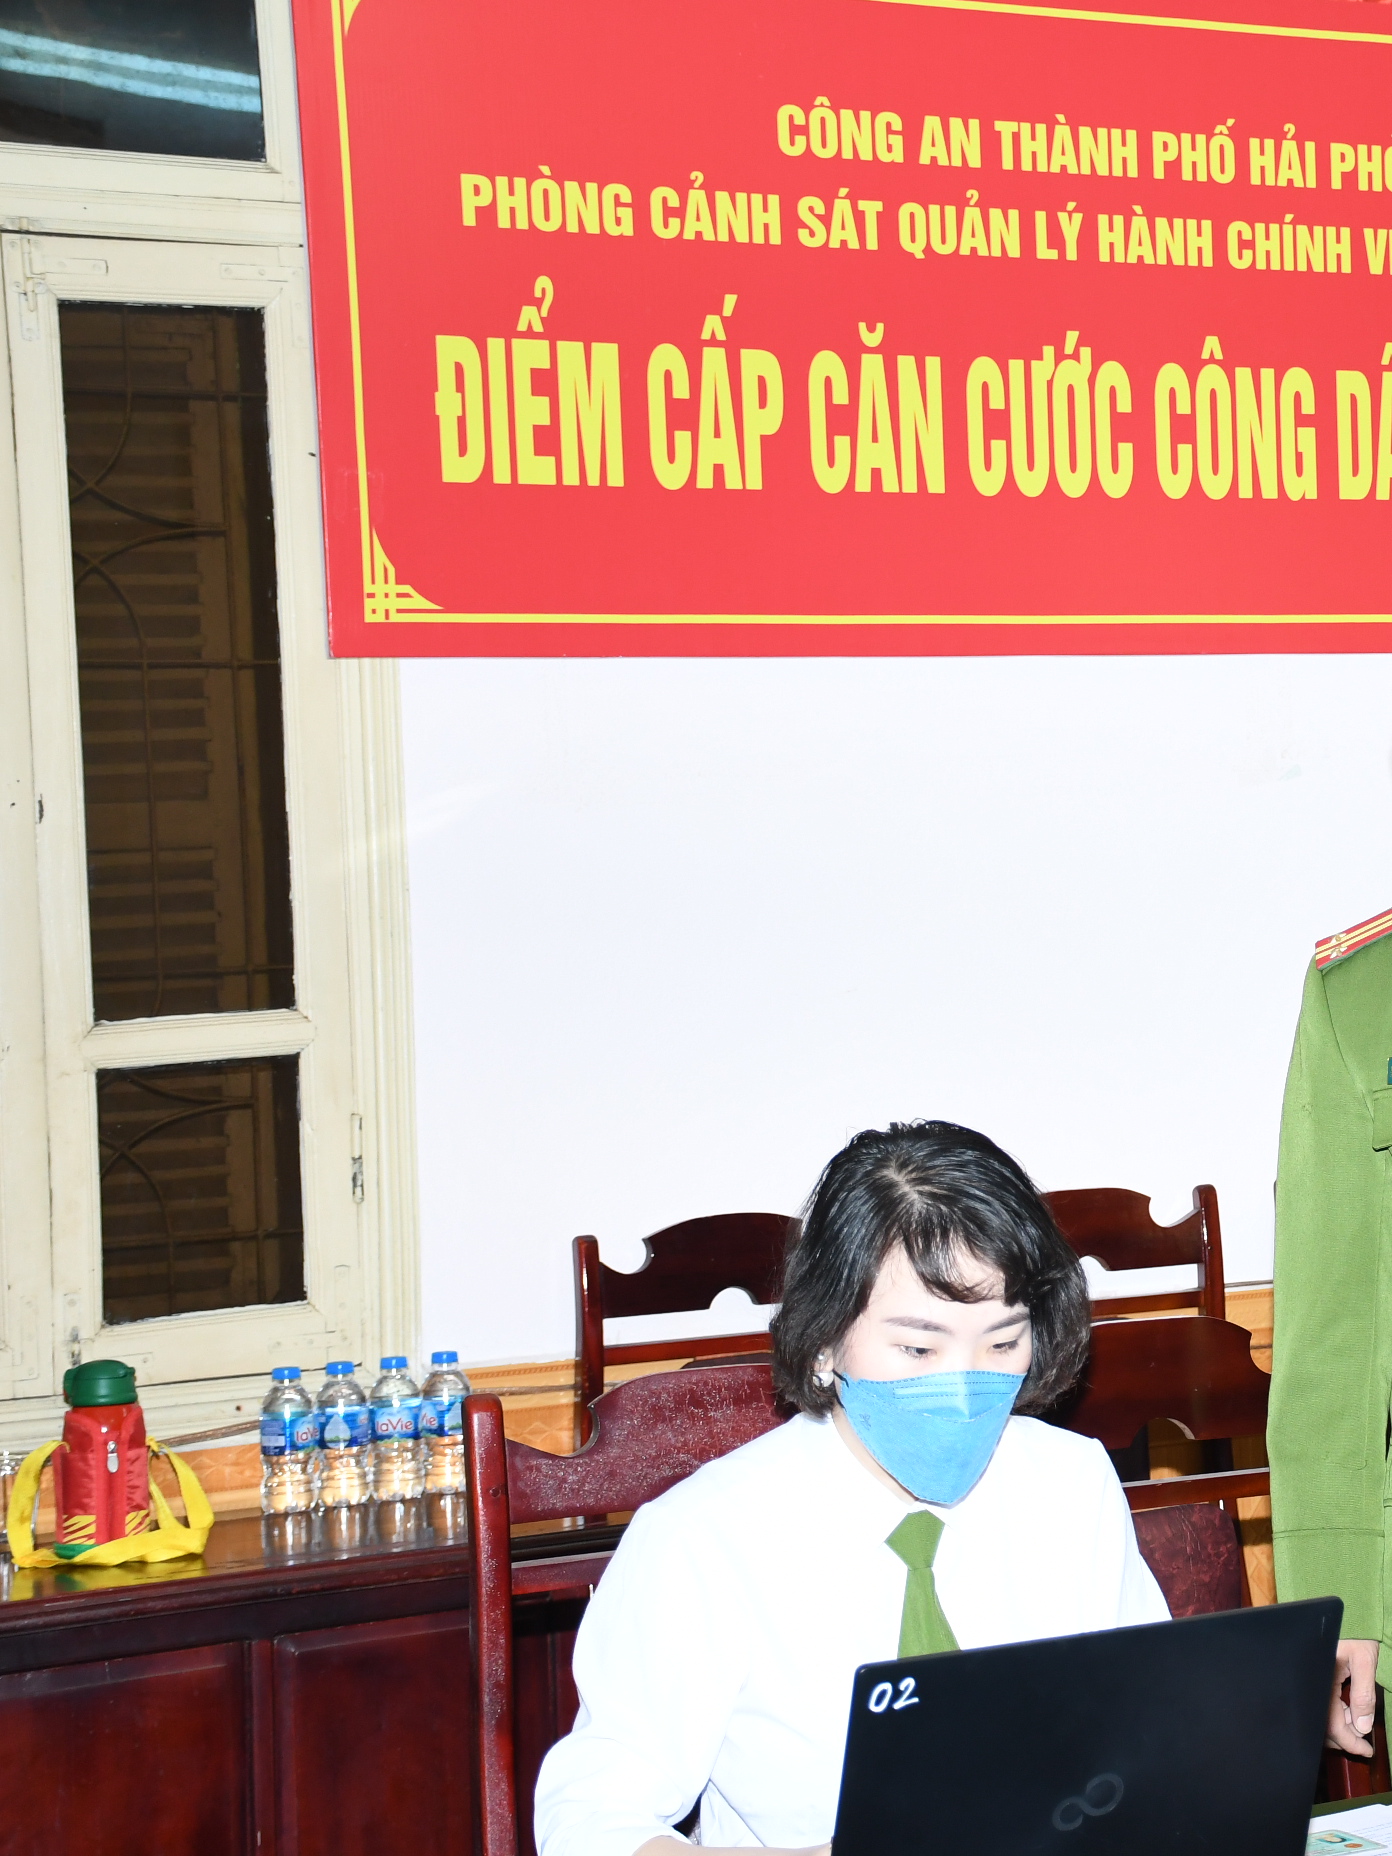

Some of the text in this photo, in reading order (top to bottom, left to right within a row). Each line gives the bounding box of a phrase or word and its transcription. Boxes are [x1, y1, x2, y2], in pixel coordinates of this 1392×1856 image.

[778, 97, 903, 162] CÔNG
[920, 116, 981, 167] AN
[995, 114, 1138, 177] THÀNH
[1153, 119, 1235, 183] PHỐ
[1250, 124, 1316, 188] HẢI
[461, 166, 633, 235] PHÒNG
[651, 172, 781, 244] CẢNH
[798, 188, 883, 250] SÁT
[899, 190, 1020, 258] QUẢN
[1036, 202, 1082, 260] LÝ
[1098, 206, 1213, 266] HÀNH
[1228, 214, 1351, 273] CHÍNH
[435, 276, 624, 486] ĐIỂM
[648, 295, 783, 489] CẤP
[809, 323, 945, 493] CĂN
[967, 331, 1133, 498] CƯỚC
[1155, 336, 1317, 501] CÔNG
[376, 1418, 413, 1432] laVie
[868, 1677, 920, 1713] 02
